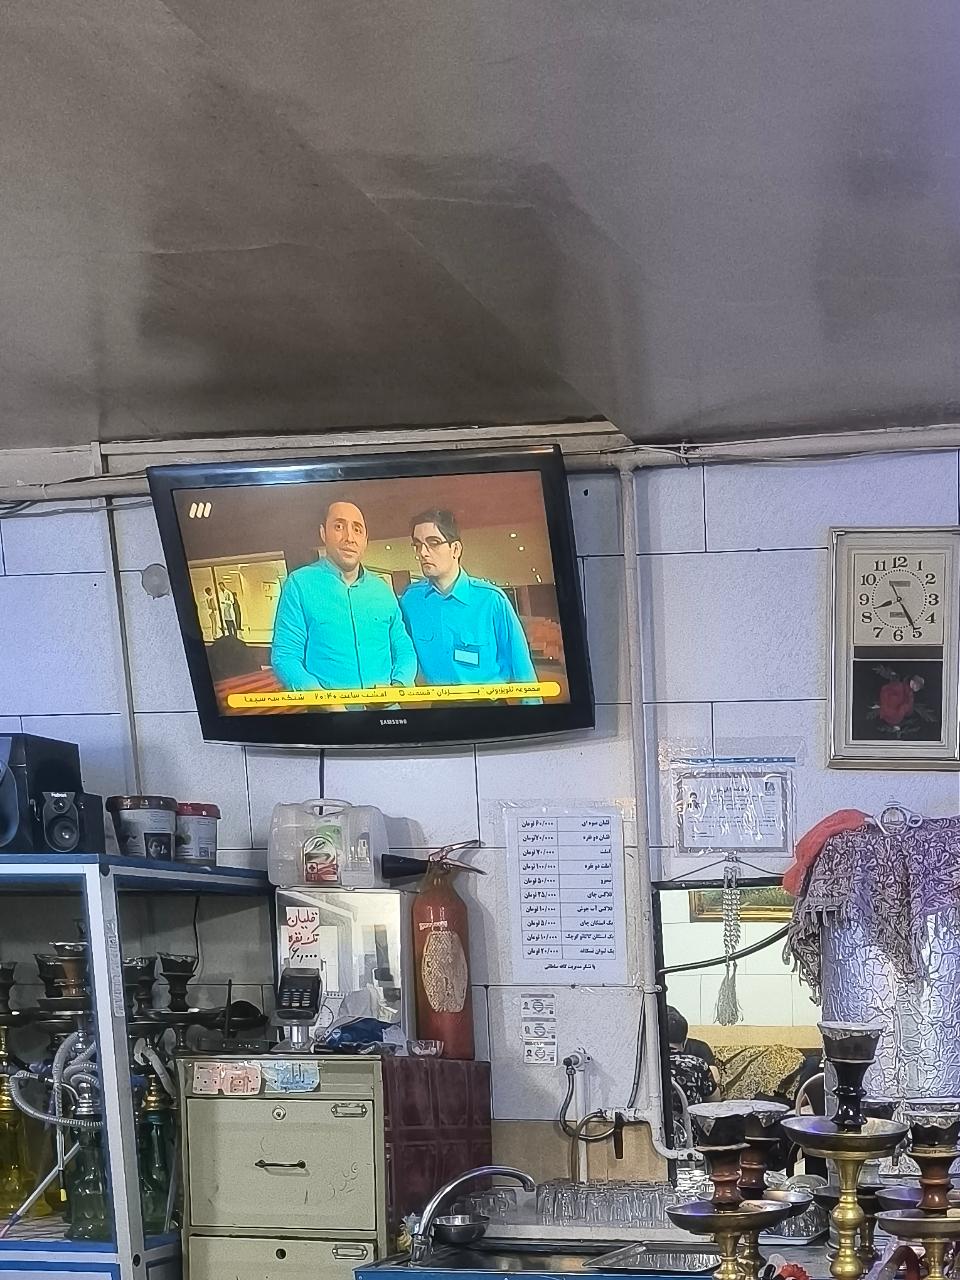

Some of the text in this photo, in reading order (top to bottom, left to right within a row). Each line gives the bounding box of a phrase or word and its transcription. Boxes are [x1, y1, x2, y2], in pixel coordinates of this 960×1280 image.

[874, 560, 886, 571] 11
[892, 556, 908, 568] 12
[917, 560, 922, 571] 1
[860, 574, 876, 586] 10
[925, 573, 936, 585] 2
[860, 594, 870, 606] 9
[928, 594, 939, 606] 3
[862, 612, 872, 624] 8
[925, 612, 936, 624] 4
[873, 626, 884, 638] 7
[893, 629, 904, 642] 6
[912, 626, 922, 638] 5
[288, 909, 318, 929] قلیان
